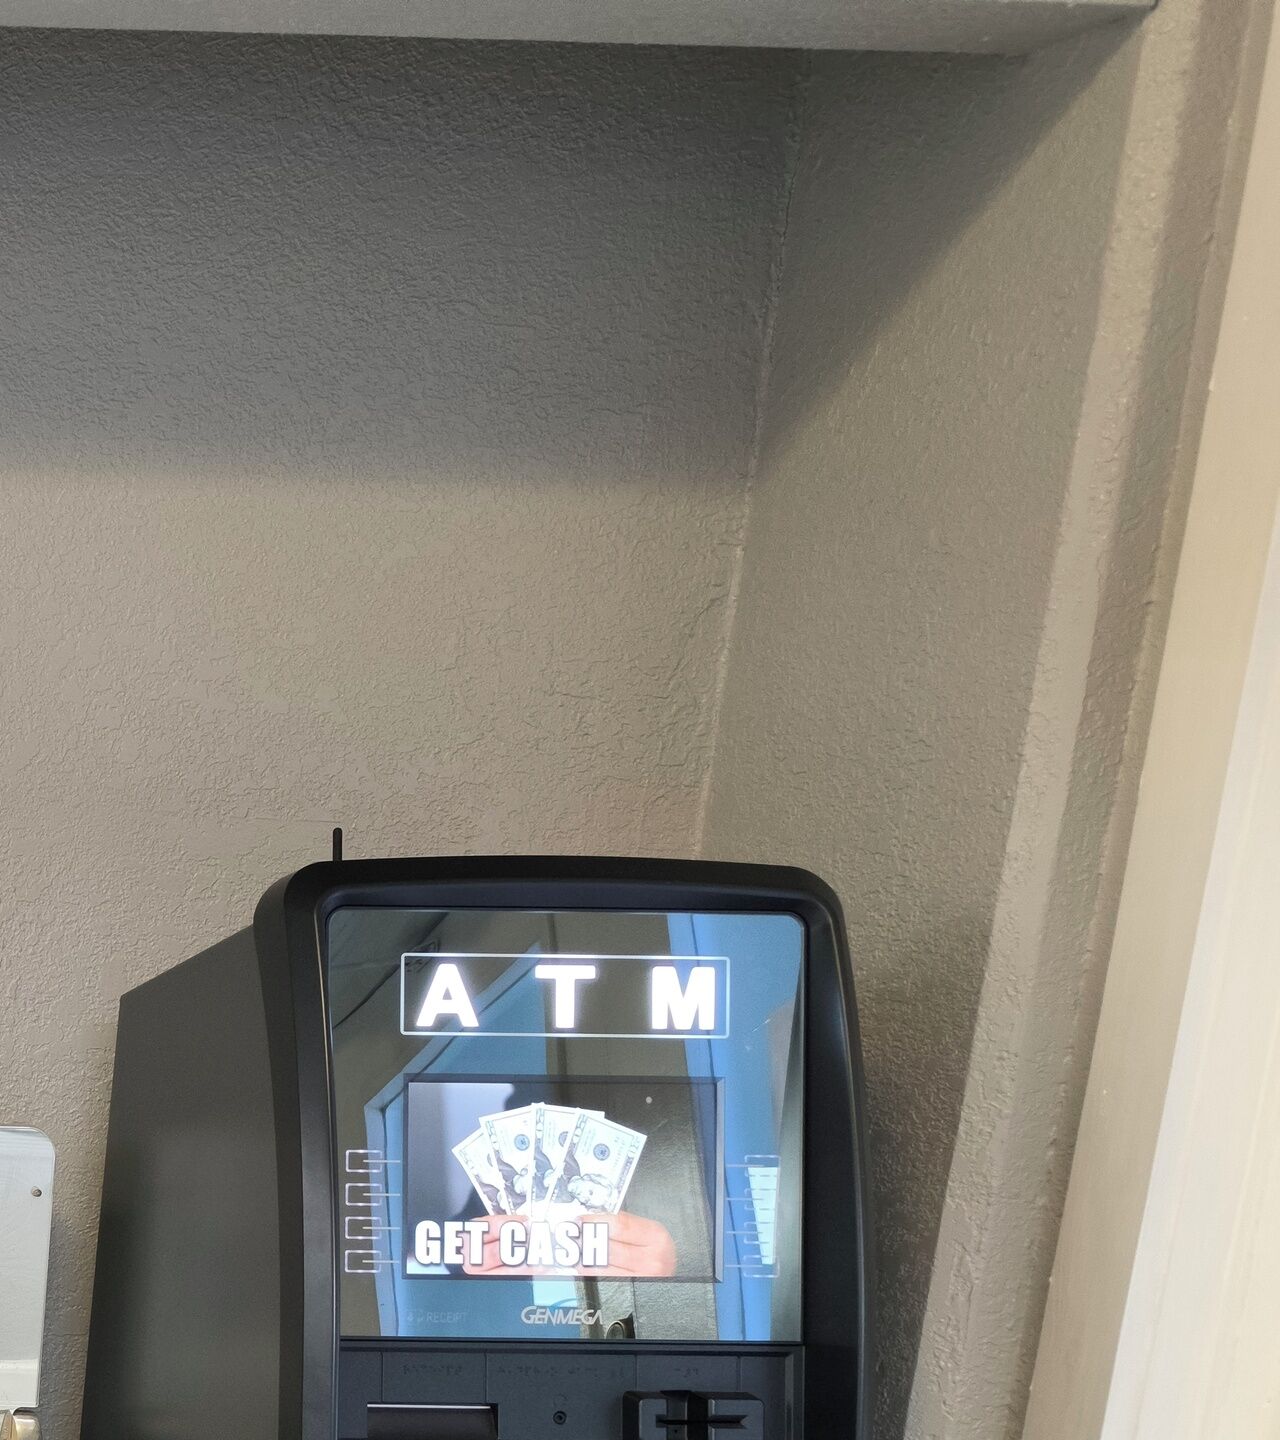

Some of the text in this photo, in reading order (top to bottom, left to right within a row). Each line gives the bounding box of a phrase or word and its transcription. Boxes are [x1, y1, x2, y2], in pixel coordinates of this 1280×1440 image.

[415, 962, 717, 1031] ATM
[414, 1220, 610, 1267] GET CASH
[521, 1305, 604, 1326] GENMEGA
